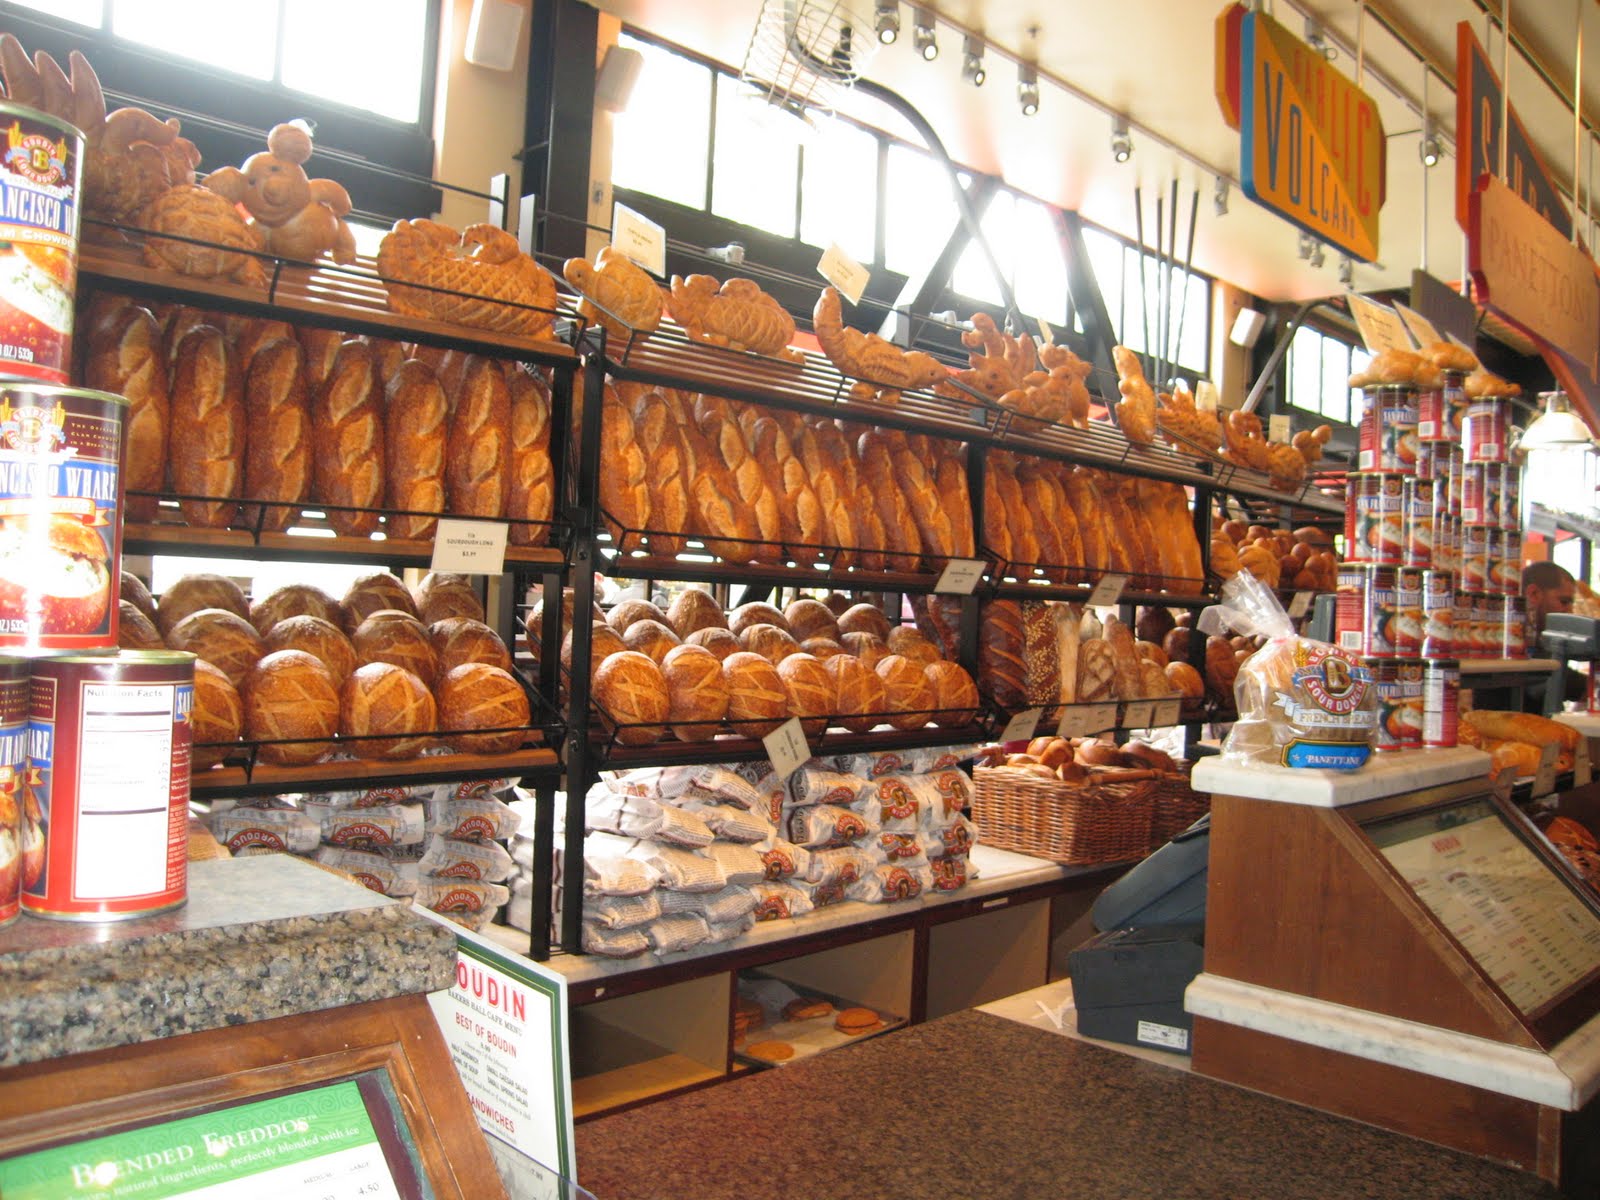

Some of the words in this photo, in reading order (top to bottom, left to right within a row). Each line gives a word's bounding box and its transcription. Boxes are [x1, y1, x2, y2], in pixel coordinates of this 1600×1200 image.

[1263, 60, 1356, 240] VOLCANO
[1488, 215, 1590, 323] PANETTON
[137, 688, 163, 698] Facts
[1307, 680, 1363, 712] SOURDOUGH
[456, 960, 526, 1022] OUDIN
[470, 1000, 487, 1017] HALL
[455, 1011, 473, 1032] BEST
[475, 1023, 485, 1038] OF
[487, 1030, 517, 1058] BOUDIN
[71, 1144, 194, 1189] BENDED
[113, 1175, 160, 1196] natural
[230, 1144, 277, 1168] perfectly
[277, 1134, 320, 1154] blended
[320, 1128, 344, 1143] with
[345, 1127, 360, 1137] ice
[357, 1182, 380, 1196] 4.50
